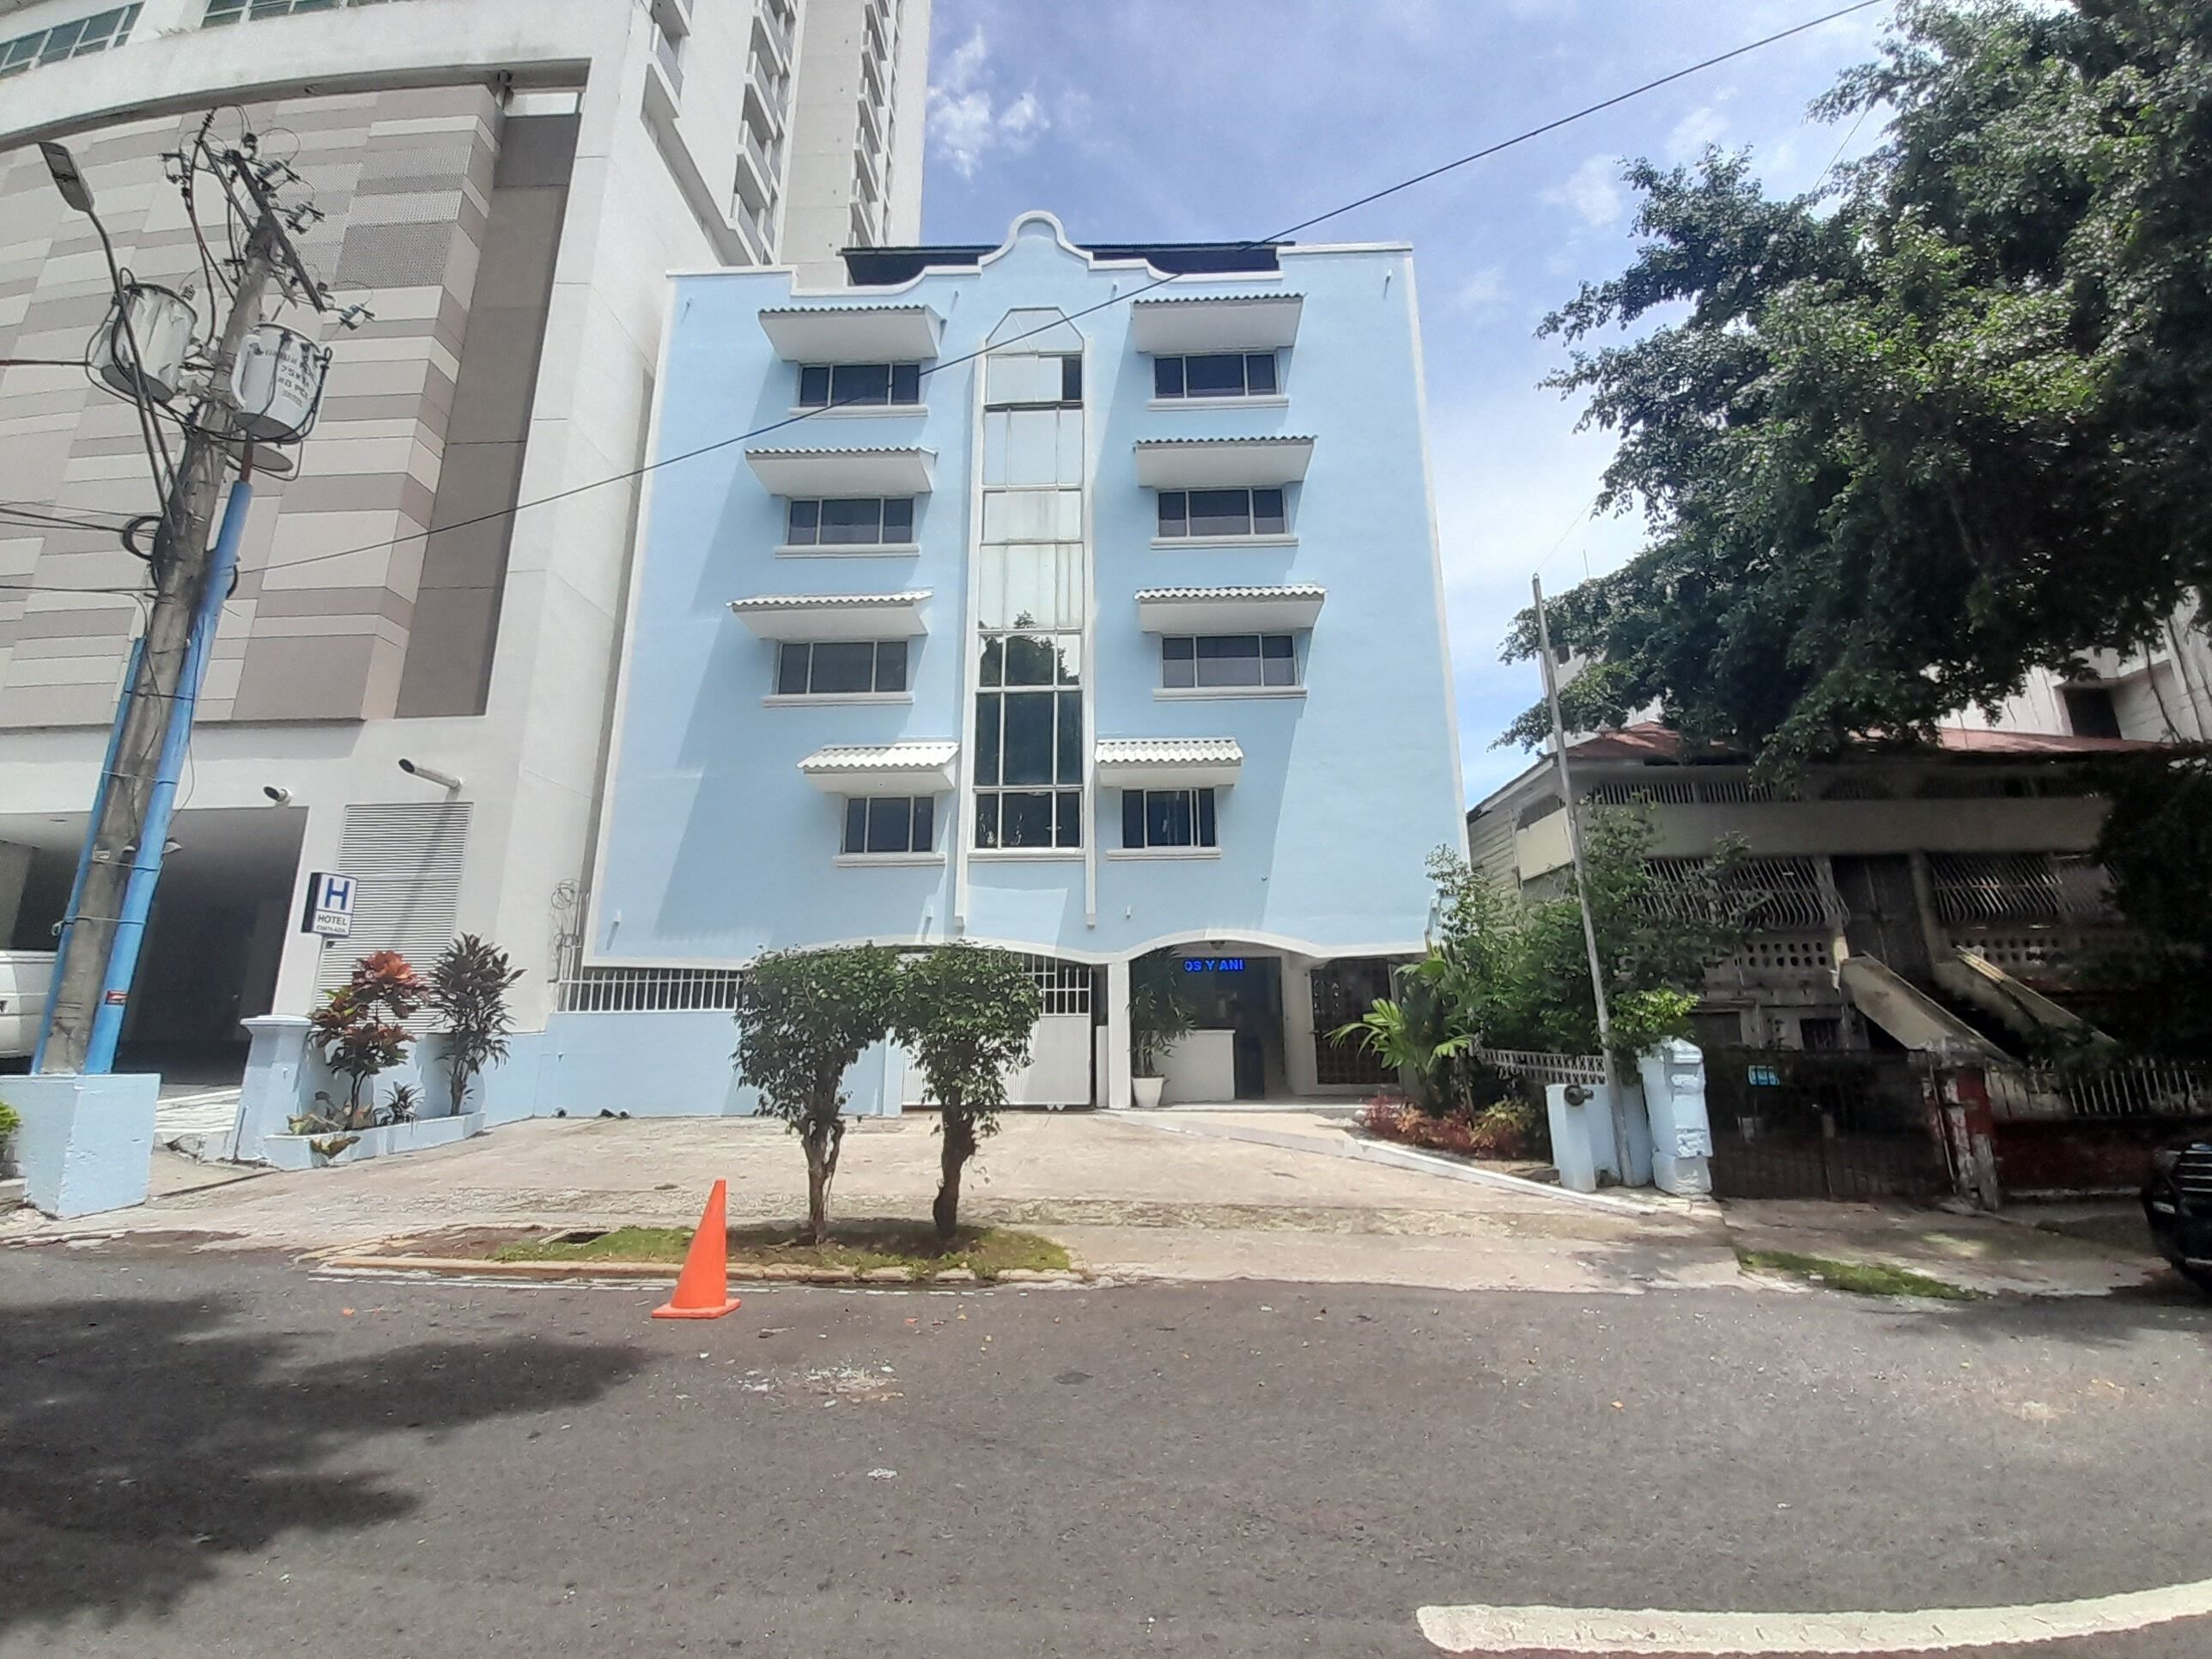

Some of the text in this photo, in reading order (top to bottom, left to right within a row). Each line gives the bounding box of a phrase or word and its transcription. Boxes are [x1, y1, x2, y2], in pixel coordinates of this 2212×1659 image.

[325, 878, 350, 911] H
[318, 914, 348, 926] HOTEL
[1184, 958, 1244, 972] OS Y ANI
